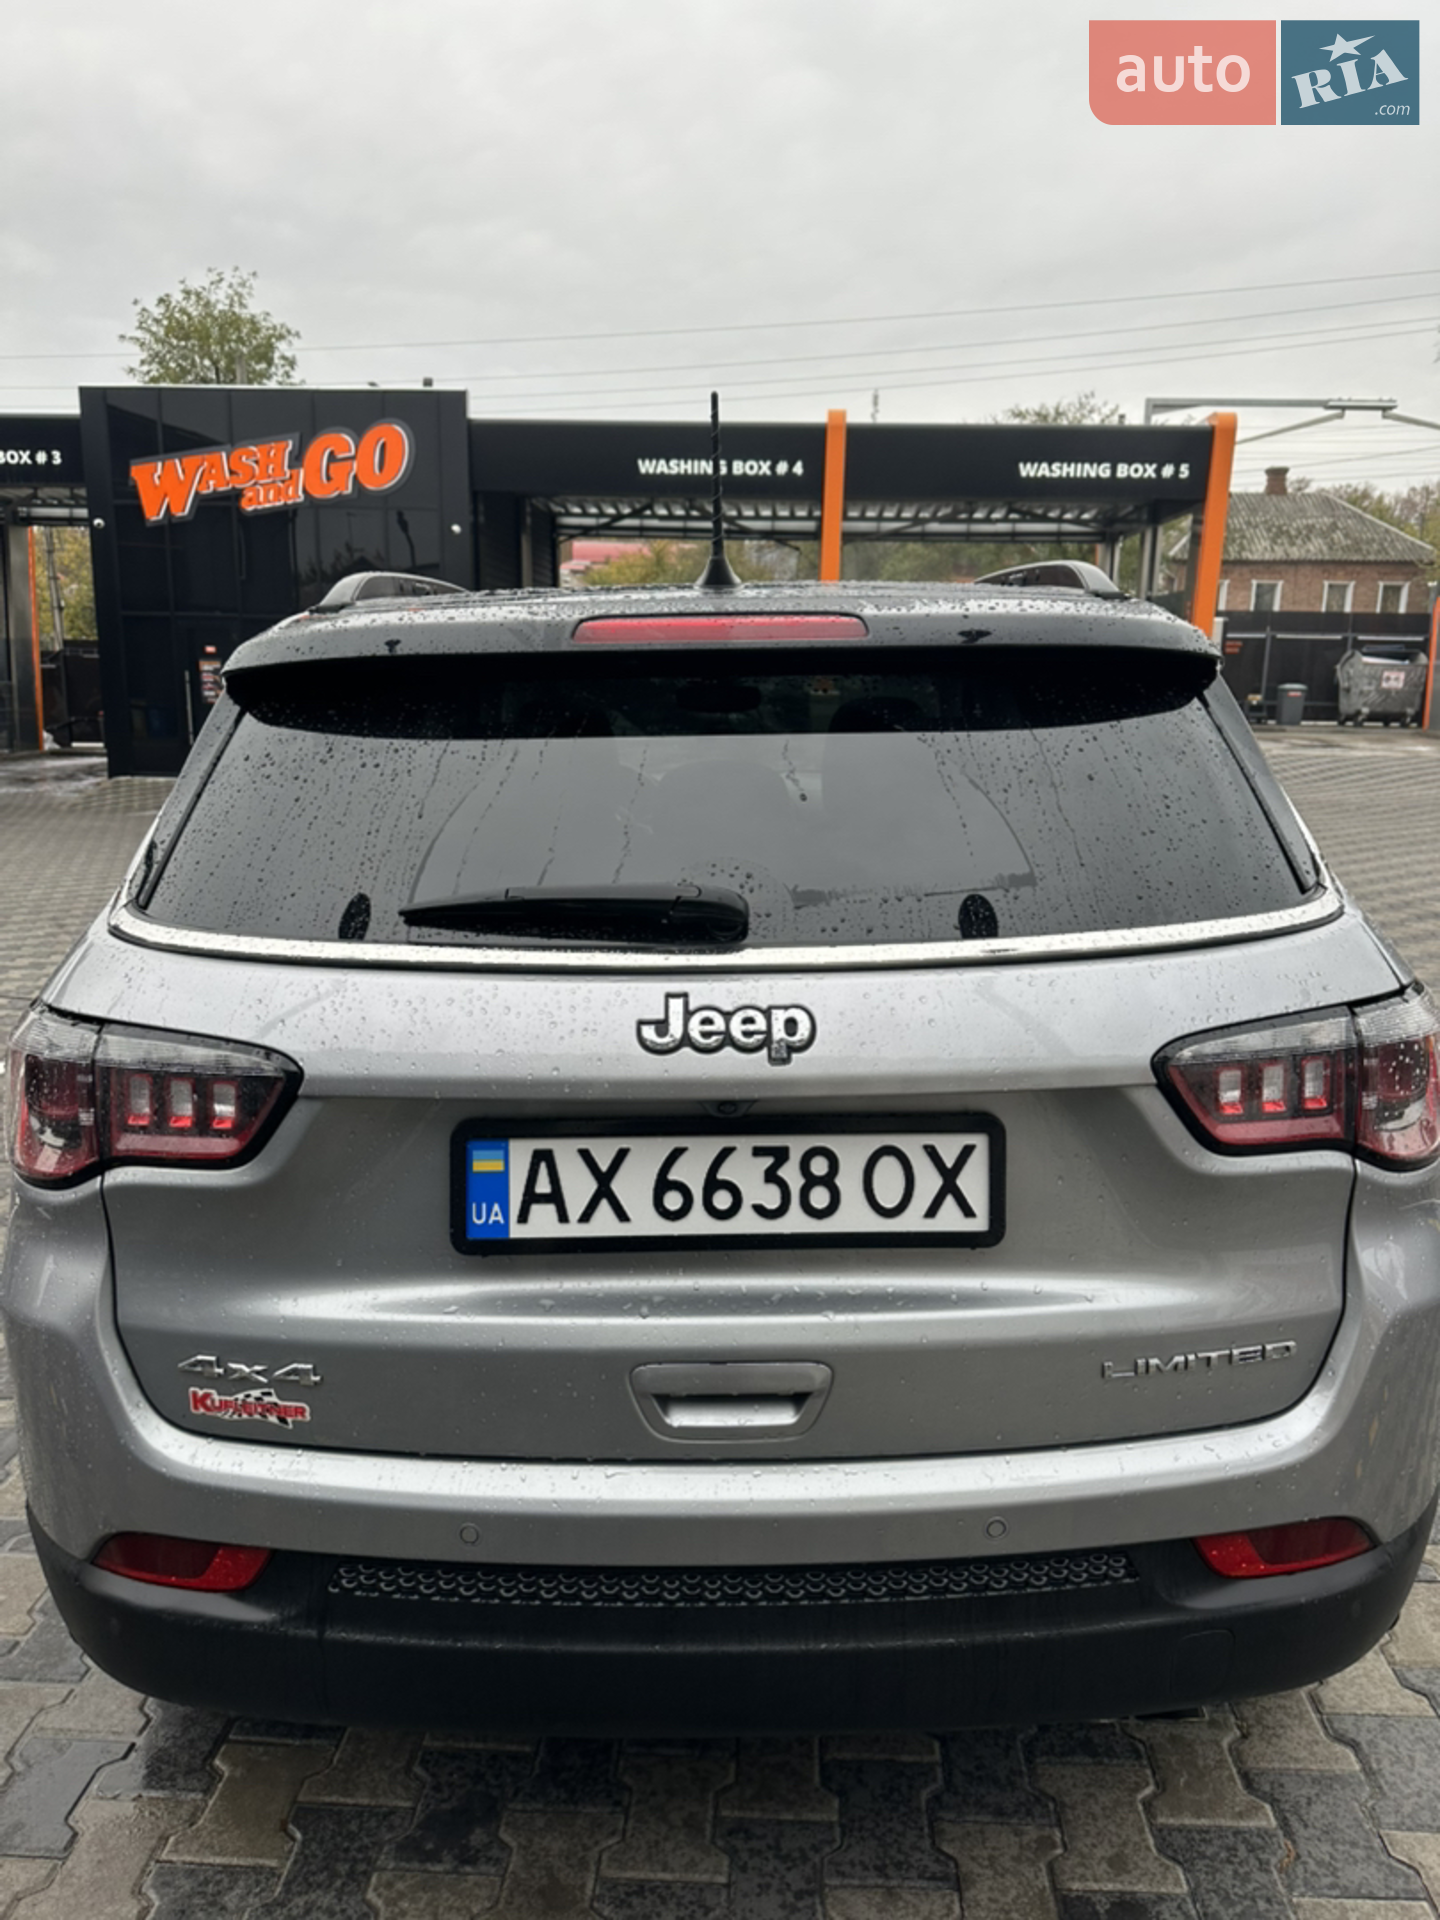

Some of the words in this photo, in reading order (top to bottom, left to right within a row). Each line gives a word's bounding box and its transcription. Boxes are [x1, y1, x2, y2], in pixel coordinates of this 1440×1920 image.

[35, 449, 48, 465] #
[51, 449, 62, 465] 3
[131, 440, 293, 521] WASH
[240, 468, 304, 512] and
[303, 423, 409, 499] GO
[637, 459, 728, 475] WASHING
[732, 460, 772, 476] BOX
[775, 460, 789, 476] #
[792, 460, 804, 476] 4
[1018, 462, 1111, 478] WASHING
[1116, 463, 1157, 478] BOX
[1160, 463, 1175, 478] #
[1179, 463, 1190, 478] 5
[636, 991, 817, 1065] Jeep
[517, 1146, 632, 1224] AX
[652, 1145, 842, 1221] 6638
[862, 1143, 977, 1219] OX
[472, 1202, 505, 1226] UA
[1101, 1340, 1298, 1379] LIMITED
